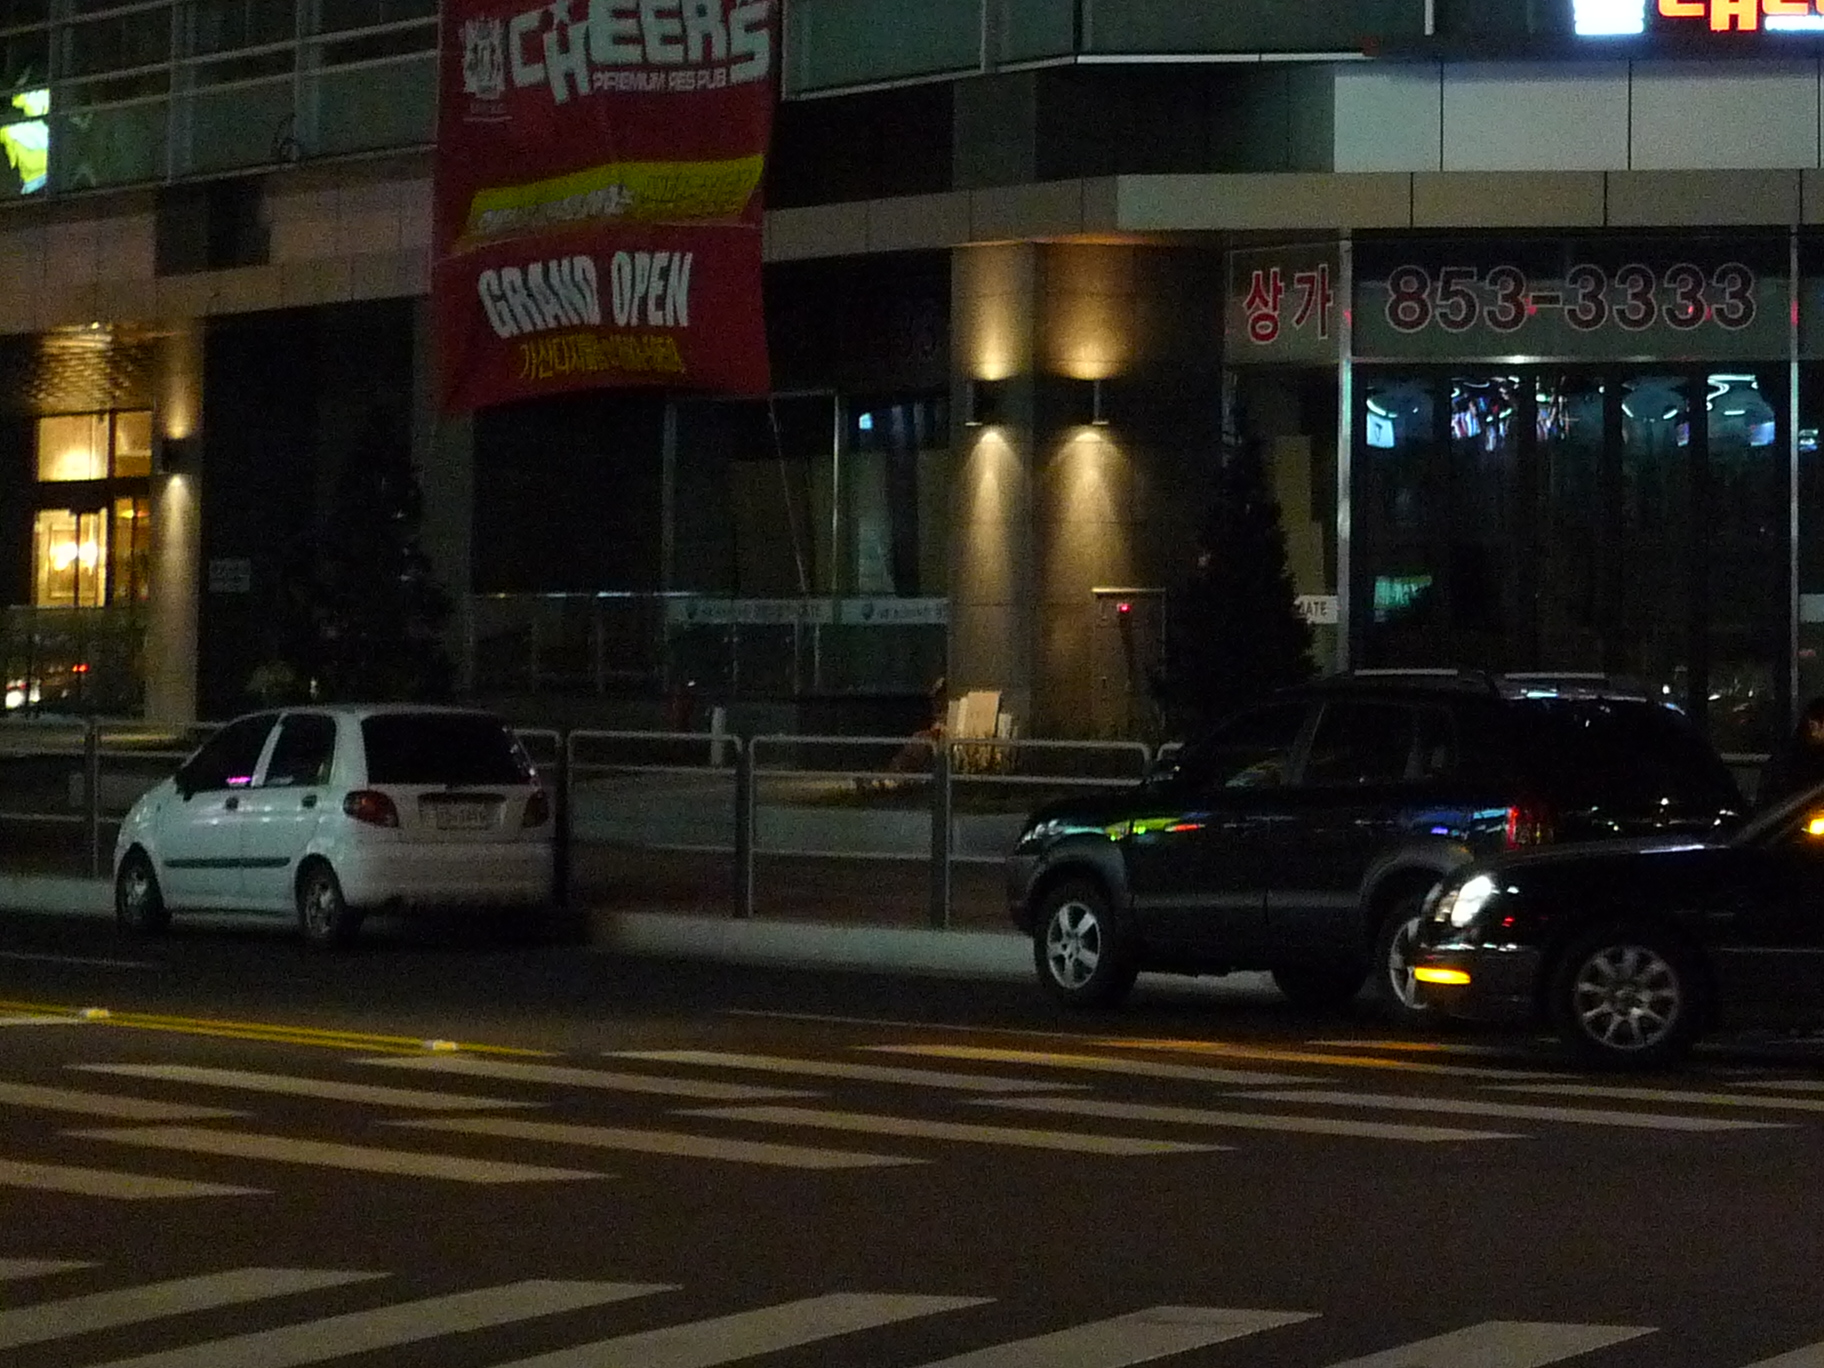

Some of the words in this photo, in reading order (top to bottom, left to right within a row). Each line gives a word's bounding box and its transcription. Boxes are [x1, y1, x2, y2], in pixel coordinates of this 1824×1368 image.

[477, 254, 600, 339] GRAND
[610, 250, 693, 328] OPEN
[1243, 262, 1335, 342] 상가
[1384, 261, 1758, 334] 853-3333
